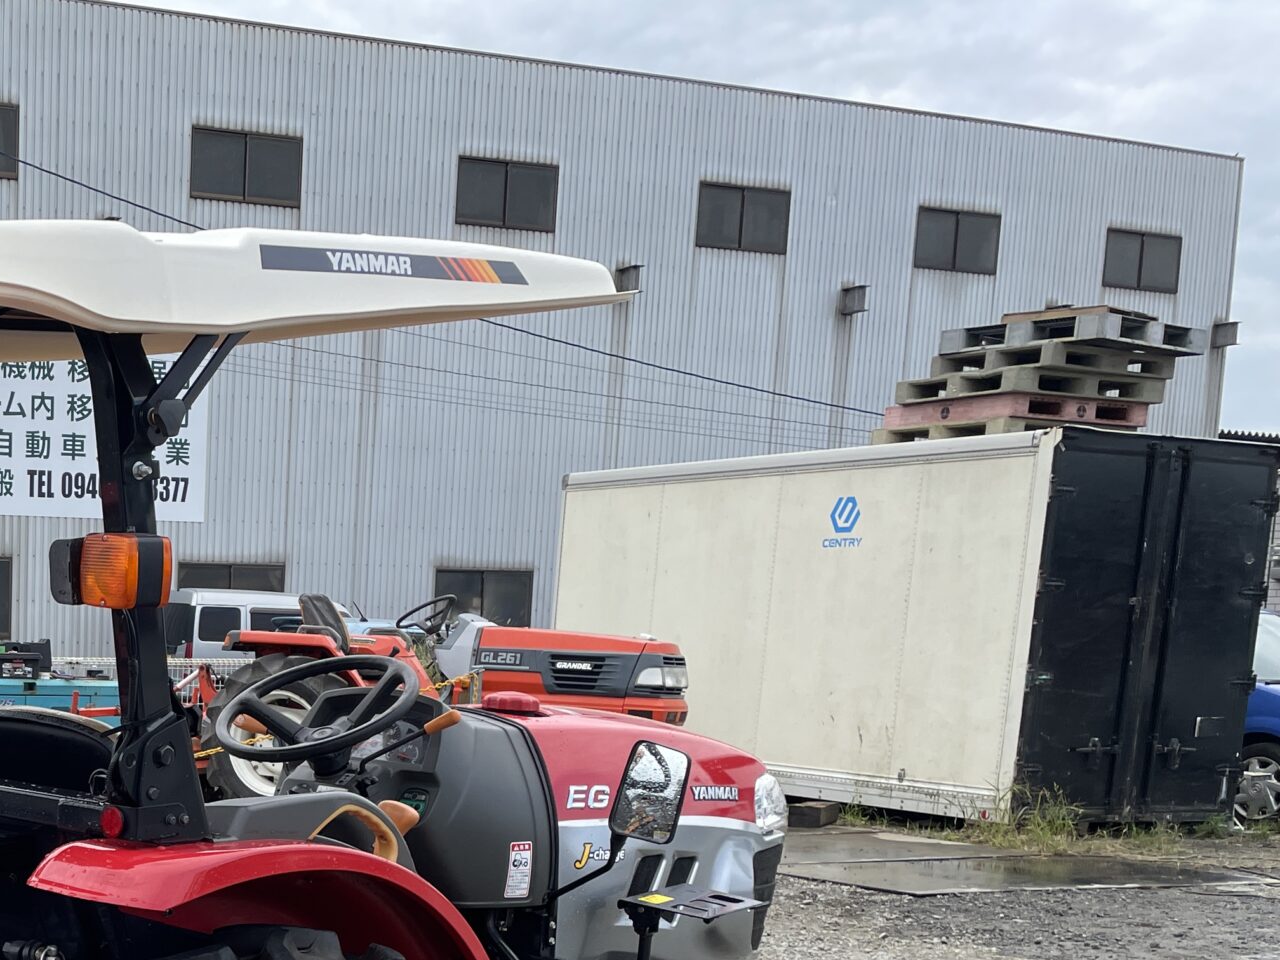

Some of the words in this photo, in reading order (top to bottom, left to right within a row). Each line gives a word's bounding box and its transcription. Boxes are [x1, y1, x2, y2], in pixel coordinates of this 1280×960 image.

[326, 250, 412, 275] YANMAR
[27, 469, 55, 499] TEL
[822, 537, 863, 548] CENTRY
[480, 651, 521, 665] GL261
[556, 661, 593, 670] GRANDEL
[566, 785, 611, 810] EG
[691, 785, 739, 801] YANMAR
